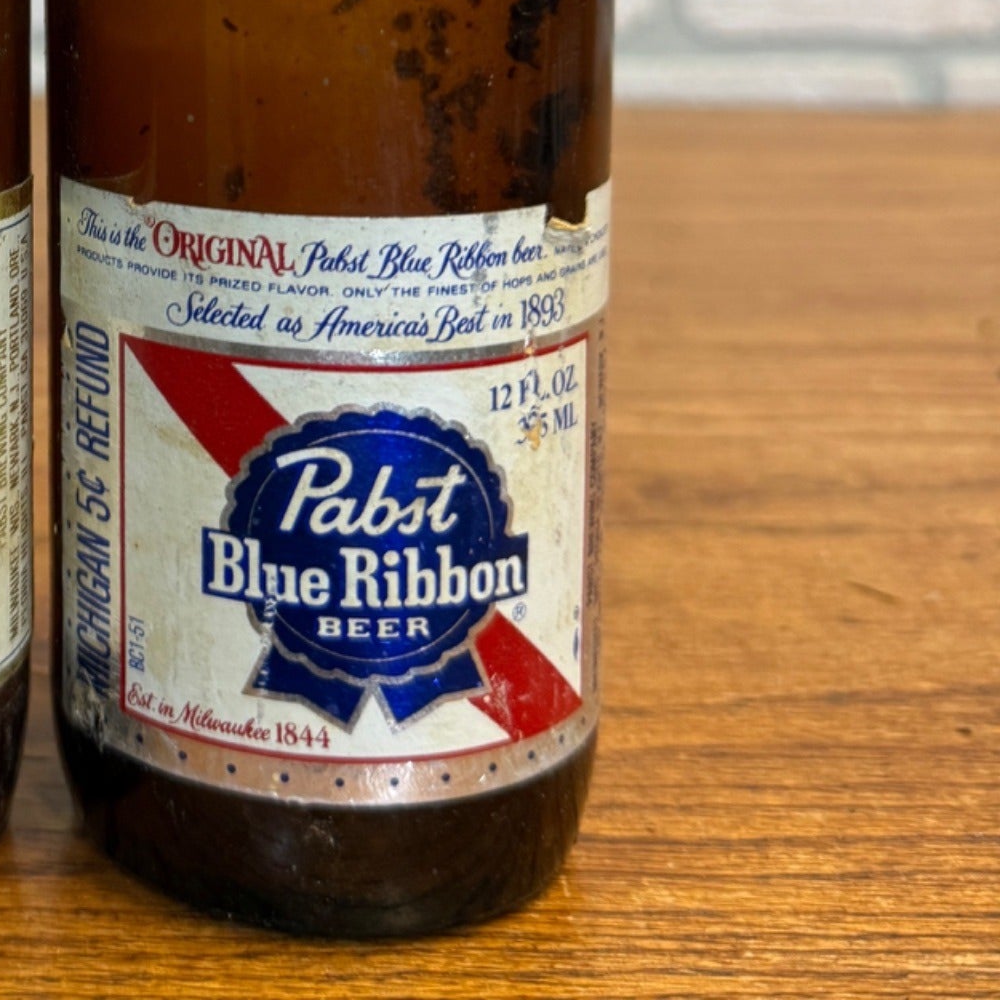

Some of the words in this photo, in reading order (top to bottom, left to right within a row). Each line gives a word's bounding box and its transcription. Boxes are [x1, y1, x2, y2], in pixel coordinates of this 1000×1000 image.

[76, 245, 124, 270] PRODUCTS
[127, 261, 178, 281] PROVIDE
[183, 272, 205, 285] ITS
[209, 276, 262, 292] PRIZED
[268, 281, 334, 298] FLAVOR.
[342, 284, 385, 299] ONLY
[391, 285, 421, 299] THE
[427, 283, 476, 297] FINEST
[481, 279, 498, 294] OF
[502, 274, 533, 290] HOPS
[536, 268, 556, 283] AND
[77, 207, 107, 241] This
[109, 221, 122, 246] is
[123, 223, 147, 252] the
[152, 220, 296, 276] ORIGINAL
[292, 239, 370, 277] Pabst
[366, 240, 432, 280] Blue
[428, 239, 508, 280] Ribbon
[511, 235, 549, 264] beer.
[166, 290, 270, 332] Selected
[276, 315, 303, 337] as
[293, 304, 430, 343] America's
[426, 303, 490, 343] Best
[491, 304, 513, 329] in
[520, 287, 565, 329] 1893
[76, 319, 111, 463] REFUND
[489, 381, 513, 412] 12
[553, 400, 578, 434] ML
[275, 446, 467, 536] Pabst
[207, 530, 331, 608] Blue
[339, 545, 524, 609] Ribbon
[76, 560, 112, 698] MICHIGAN
[128, 616, 146, 673] BC1-51
[318, 616, 431, 638] BEER
[127, 682, 157, 712] Est.
[158, 699, 175, 718] in
[168, 700, 272, 742] Milwaukee
[275, 721, 331, 749] 1844
